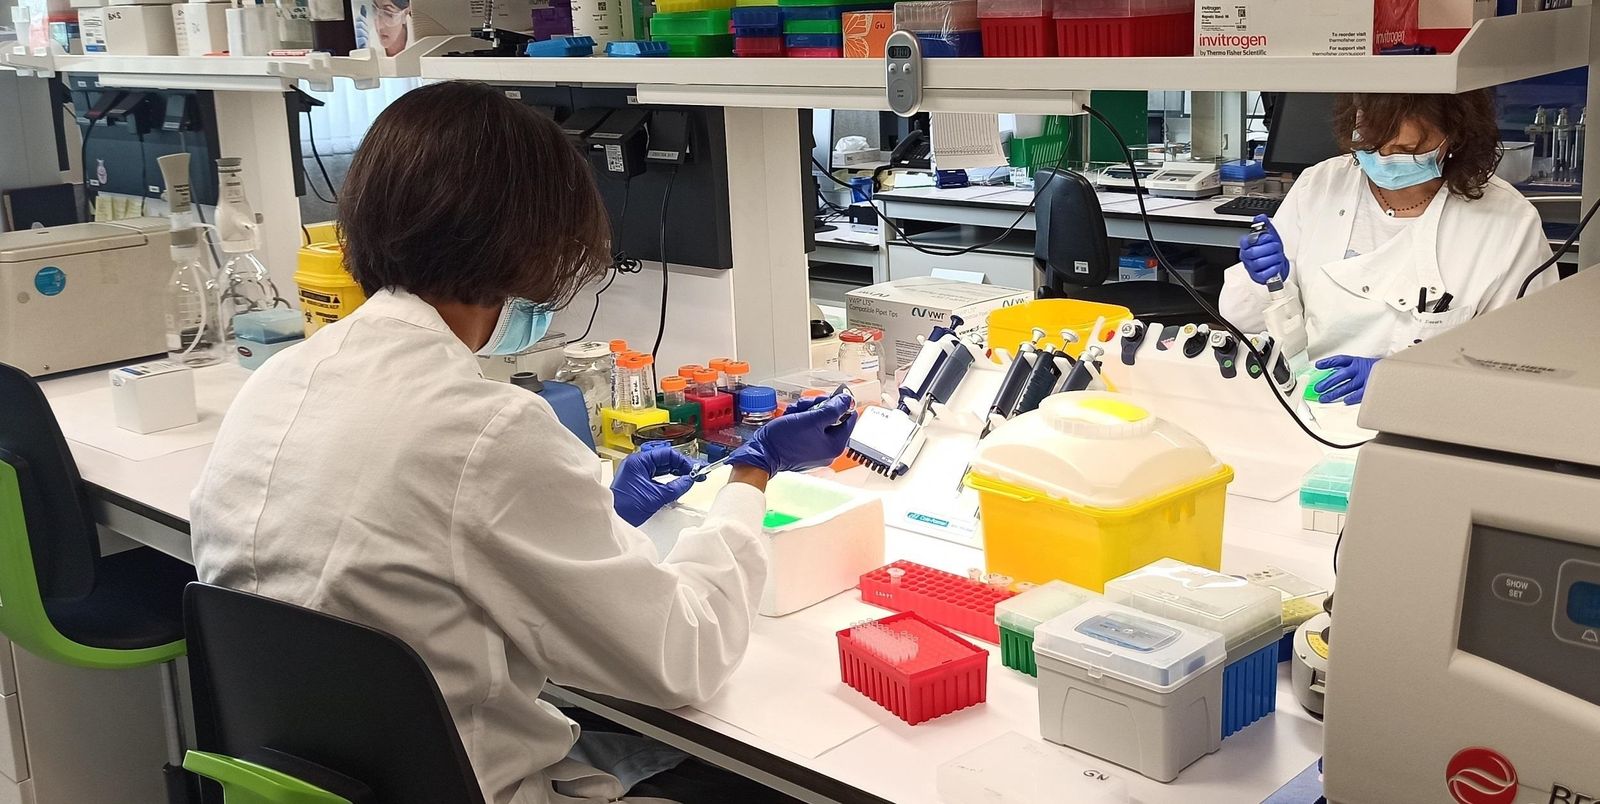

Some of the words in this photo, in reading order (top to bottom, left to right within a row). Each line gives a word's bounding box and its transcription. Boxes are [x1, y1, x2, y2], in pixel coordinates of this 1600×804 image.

[1199, 33, 1267, 49] invitrogen
[1375, 30, 1405, 45] invitrogen
[849, 304, 875, 314] Compatible
[876, 308, 888, 317] Pipet
[888, 310, 898, 318] Tips
[928, 311, 945, 320] vwr
[1505, 578, 1529, 590] SHOW
[1508, 589, 1523, 598] SET
[1083, 769, 1110, 781] GN
